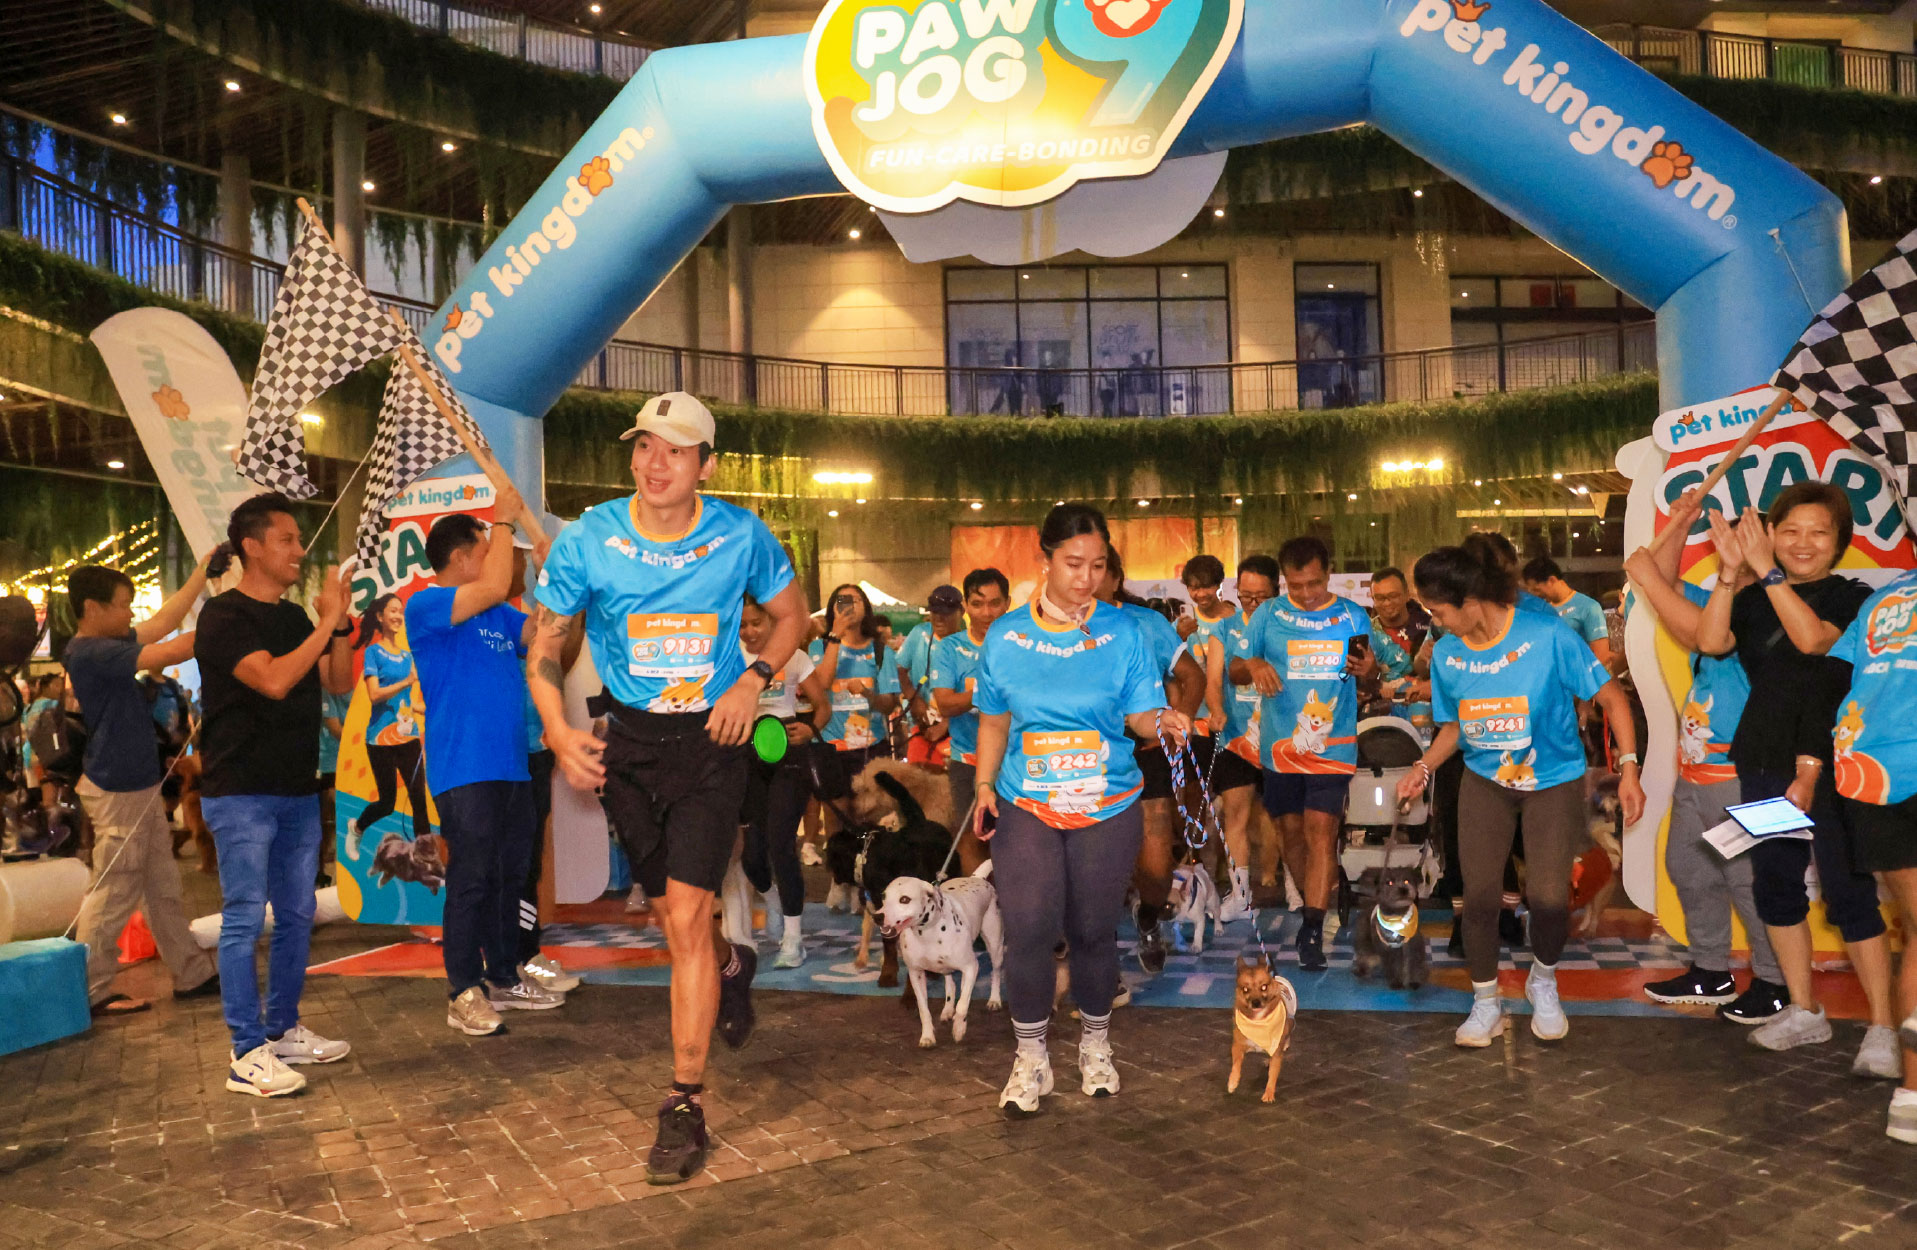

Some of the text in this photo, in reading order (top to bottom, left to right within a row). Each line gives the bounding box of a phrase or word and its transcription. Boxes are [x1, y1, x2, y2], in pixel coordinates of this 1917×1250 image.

[856, 0, 1032, 69] PAW
[1400, 0, 1506, 65] pet
[858, 36, 1027, 122] JOG
[435, 291, 494, 373] pet
[1670, 414, 1712, 444] pet
[387, 493, 414, 512] pet
[663, 637, 712, 655] 9131
[1309, 655, 1340, 666] 9240
[1486, 716, 1526, 732] 9241
[1049, 752, 1098, 771] 9242
